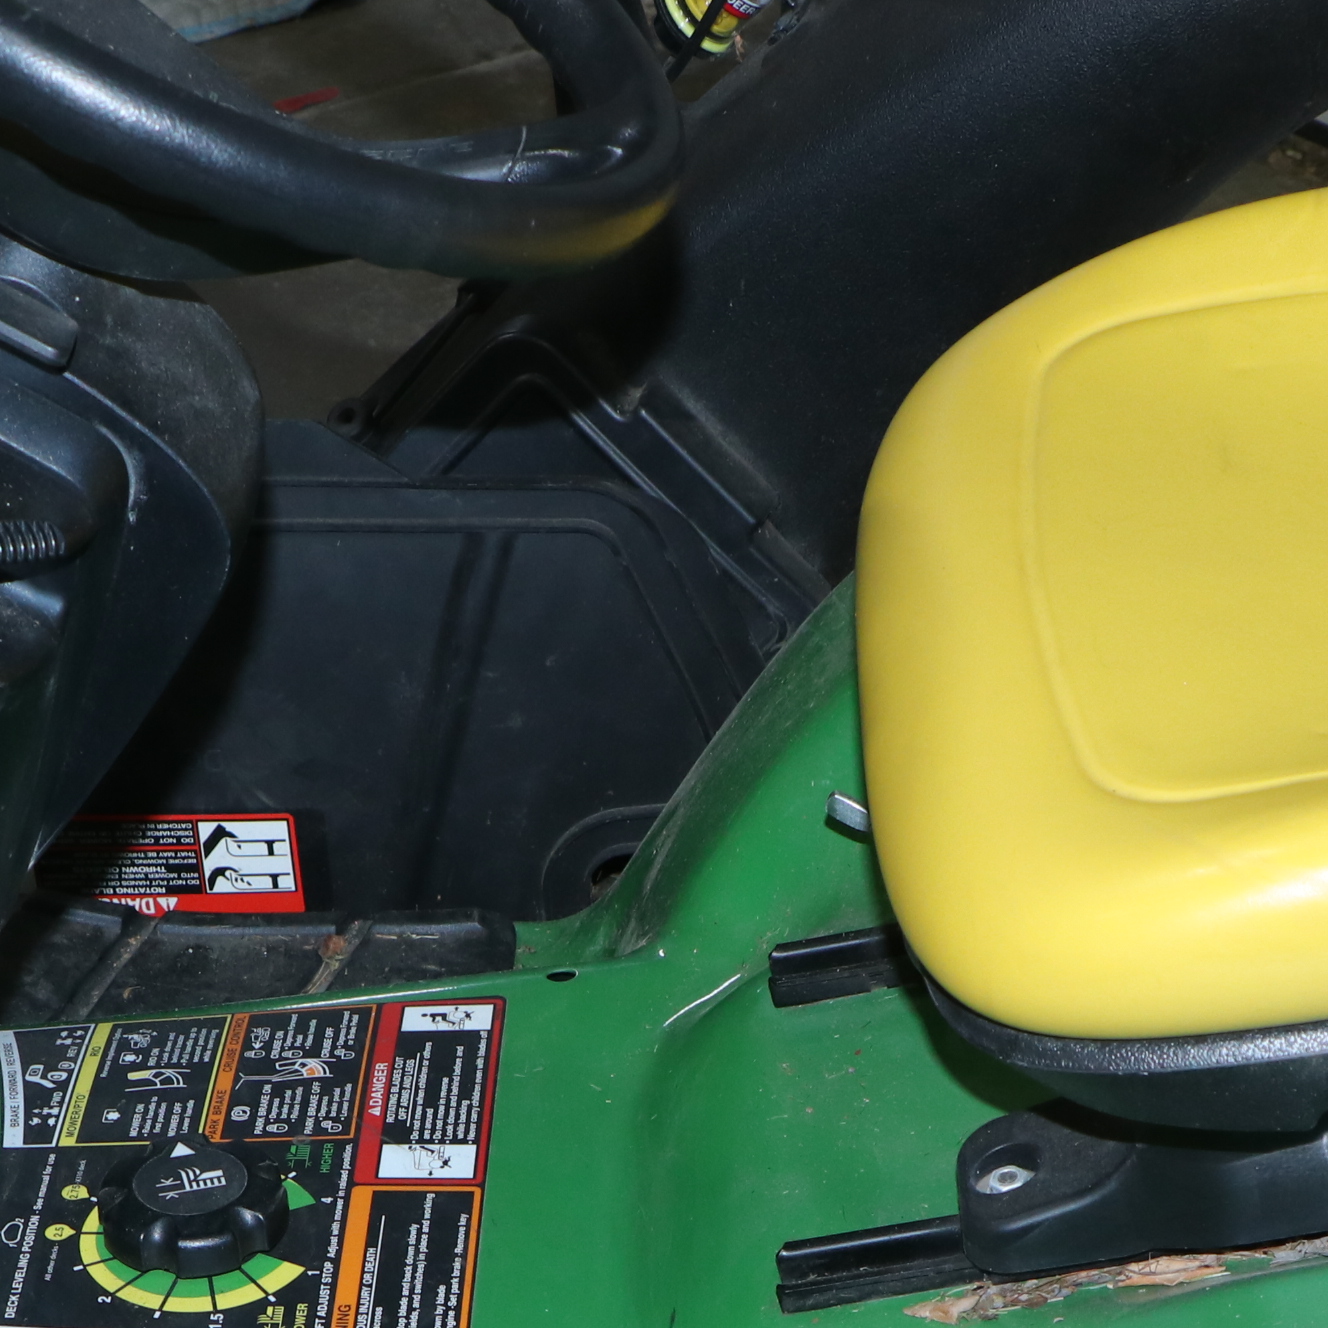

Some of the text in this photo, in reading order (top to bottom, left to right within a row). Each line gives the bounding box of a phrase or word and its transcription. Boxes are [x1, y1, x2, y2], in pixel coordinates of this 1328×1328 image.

[116, 886, 166, 894] ROTATING
[67, 1046, 78, 1057] REV
[271, 1040, 282, 1058] CRUISE
[321, 1027, 334, 1058] CRUISE OFF
[148, 1048, 160, 1066] RIO ON
[3, 1043, 20, 1127] BRAKE FORWARD REVERSE
[208, 1016, 246, 1139] PARK BRAKE CRUISE CONTROL
[370, 1063, 388, 1106] DANGER
[51, 1092, 63, 1106] FWD
[65, 1046, 101, 1137] MOWER/PTO RIO
[386, 1057, 404, 1122] ROTATING BLADES CUT
[398, 1059, 415, 1120] OFF ARMS AND LEGS
[167, 1102, 182, 1136] MOWER OFF
[254, 1084, 272, 1134] PARK BRAKE ON
[304, 1081, 321, 1134] PARK BRAKE OFF
[129, 1104, 144, 1136] MOWER ON
[319, 1143, 334, 1173] HIGHER
[340, 1143, 353, 1169] position.
[337, 1171, 348, 1189] raised
[69, 1186, 81, 1199] 2.75
[334, 1198, 344, 1220] mower
[4, 1154, 56, 1318] DECK LEVELING POSITION See manual for use
[53, 1227, 64, 1237] 2.5
[330, 1222, 340, 1235] with
[326, 1237, 339, 1258] Adjust
[366, 1248, 376, 1271] DEATH
[323, 1262, 334, 1283] STOP
[364, 1273, 373, 1284] OR
[318, 1285, 331, 1316] ADJUST
[359, 1286, 371, 1313] INJURY
[436, 1285, 446, 1304] blade
[209, 1313, 224, 1328] 1.5
[435, 1306, 445, 1314] by
